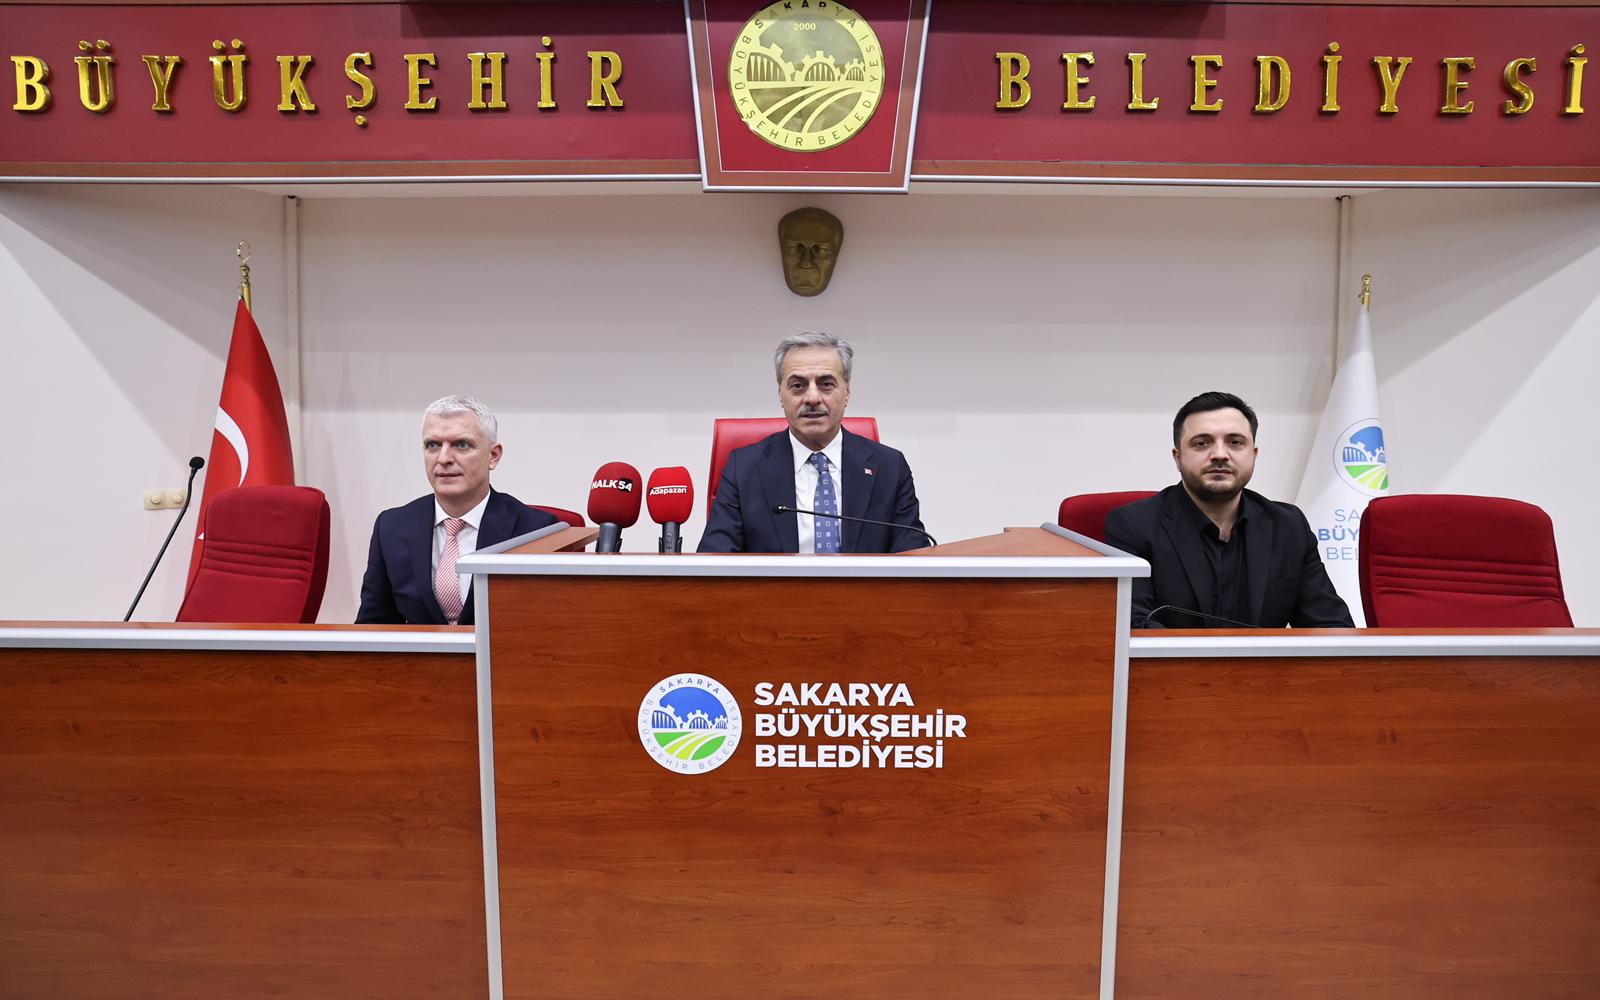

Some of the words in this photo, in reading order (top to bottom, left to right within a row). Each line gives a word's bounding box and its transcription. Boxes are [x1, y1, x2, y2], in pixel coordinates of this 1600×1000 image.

[754, 0, 857, 29] SAKARYA
[793, 22, 816, 31] 2000
[11, 36, 624, 127] BÜYÜKŞEHİR
[995, 42, 1587, 115] BELEDİYESİ
[659, 677, 720, 694] SAKARYA
[754, 683, 914, 706] SAKARYA
[755, 708, 966, 742] BÜYÜKŞEHİR
[755, 739, 943, 768] BELEDİYESİ
